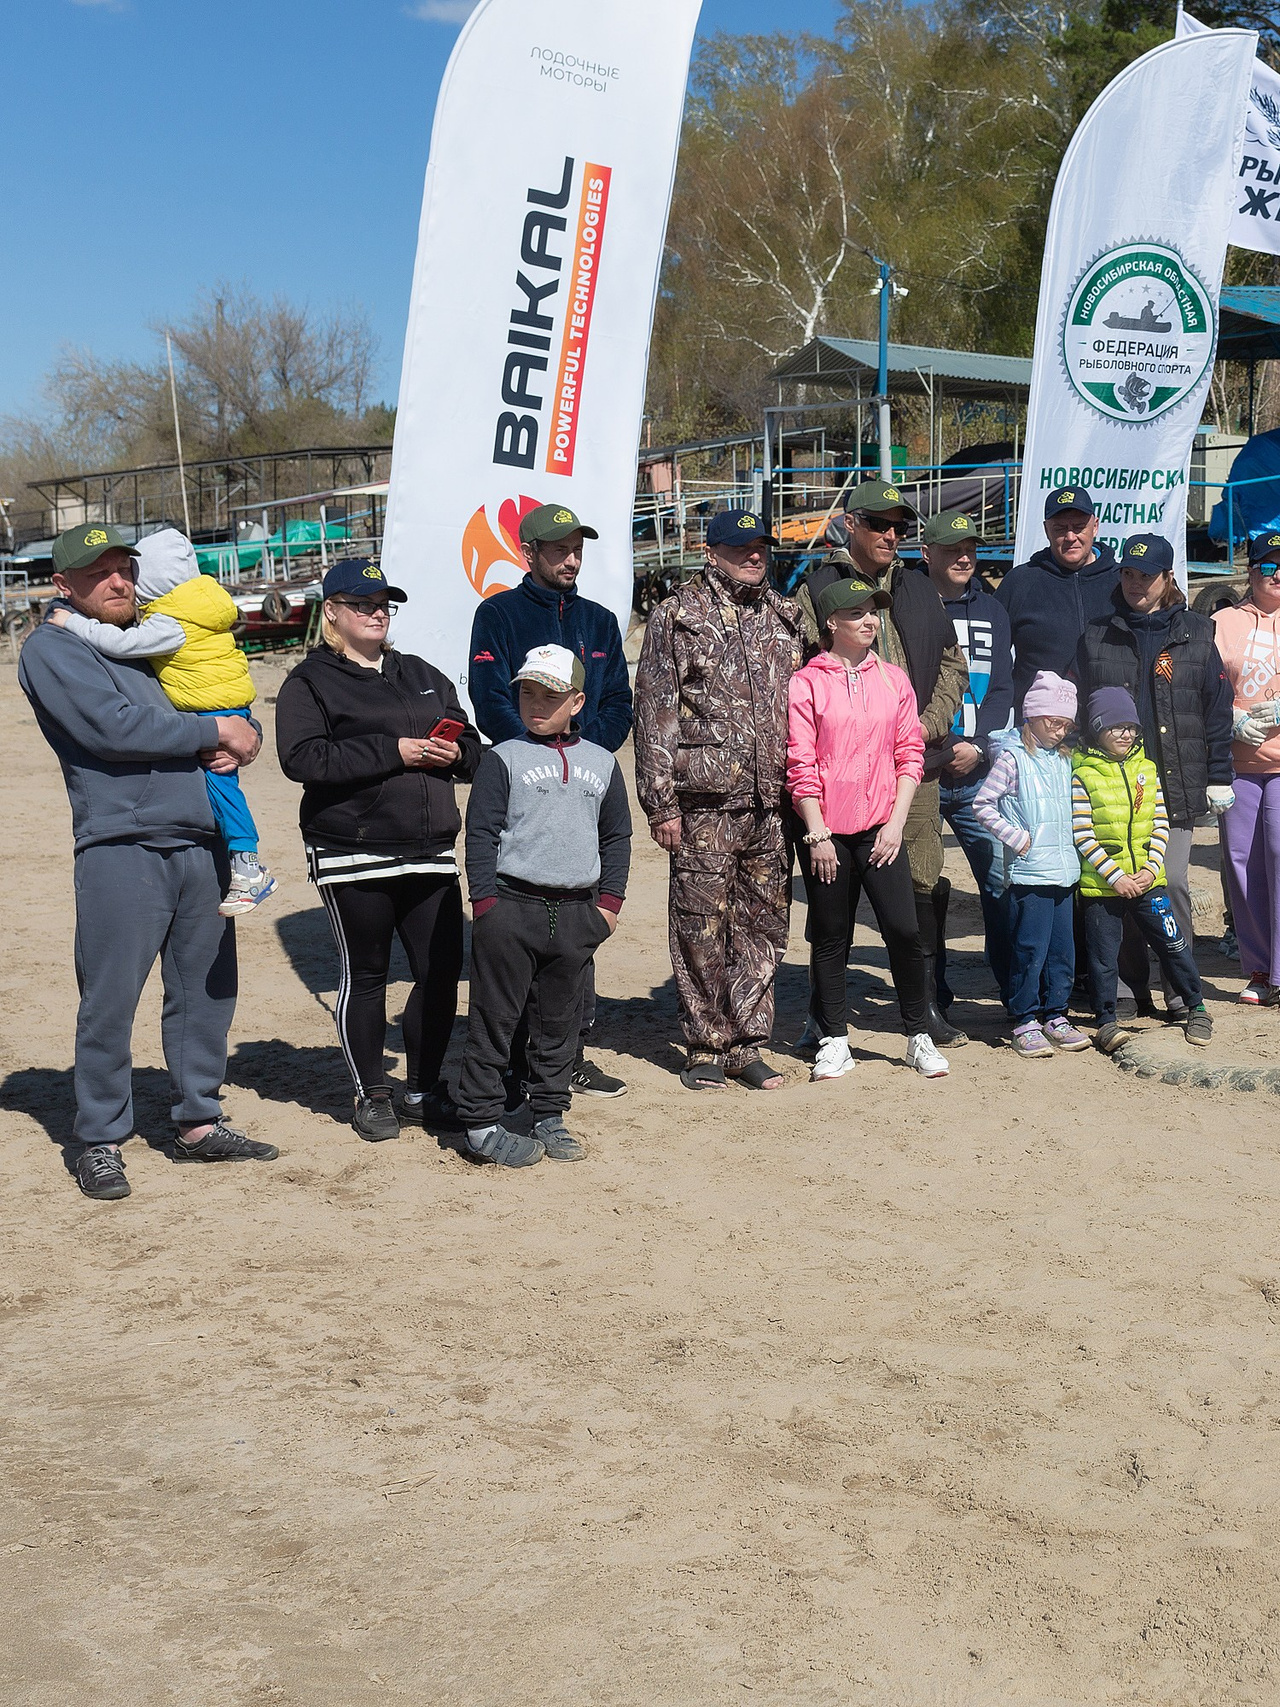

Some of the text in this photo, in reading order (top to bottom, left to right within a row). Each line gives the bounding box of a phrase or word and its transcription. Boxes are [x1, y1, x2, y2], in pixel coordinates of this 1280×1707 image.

[530, 46, 620, 80] ЛОДОЧНЫЕ
[540, 65, 607, 92] МОТОРЫ
[1080, 260, 1198, 328] НОВОСИБИРСКАЯ ОБЛАСТНАЯ
[492, 156, 575, 470] BAIKAL
[553, 178, 604, 462] POWERFUL TECHNOLOGIES
[1092, 339, 1179, 360] ФЕДЕРАЦИЯ
[1079, 358, 1156, 373] РЫБОЛОВНОГО
[521, 765, 560, 786] #REAL
